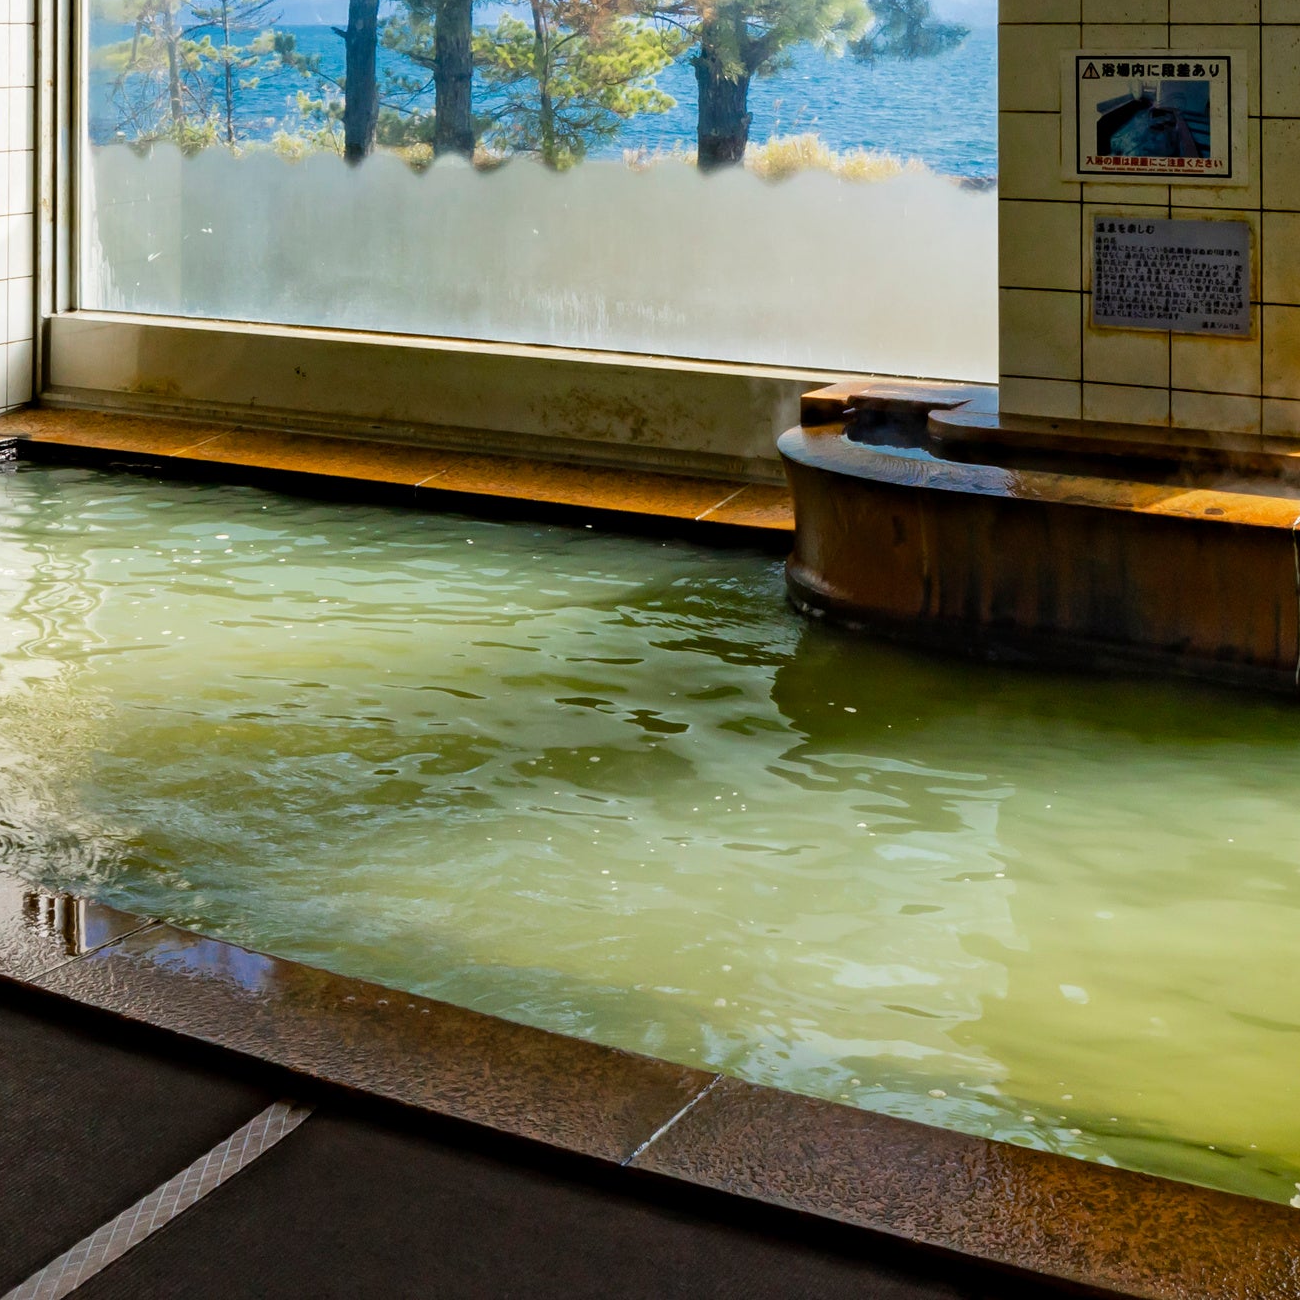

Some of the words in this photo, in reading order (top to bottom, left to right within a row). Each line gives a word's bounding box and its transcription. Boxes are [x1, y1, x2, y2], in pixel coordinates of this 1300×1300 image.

[1102, 63, 1220, 78] 浴場内に段差あり
[1096, 223, 1155, 234] 温泉を楽しむ
